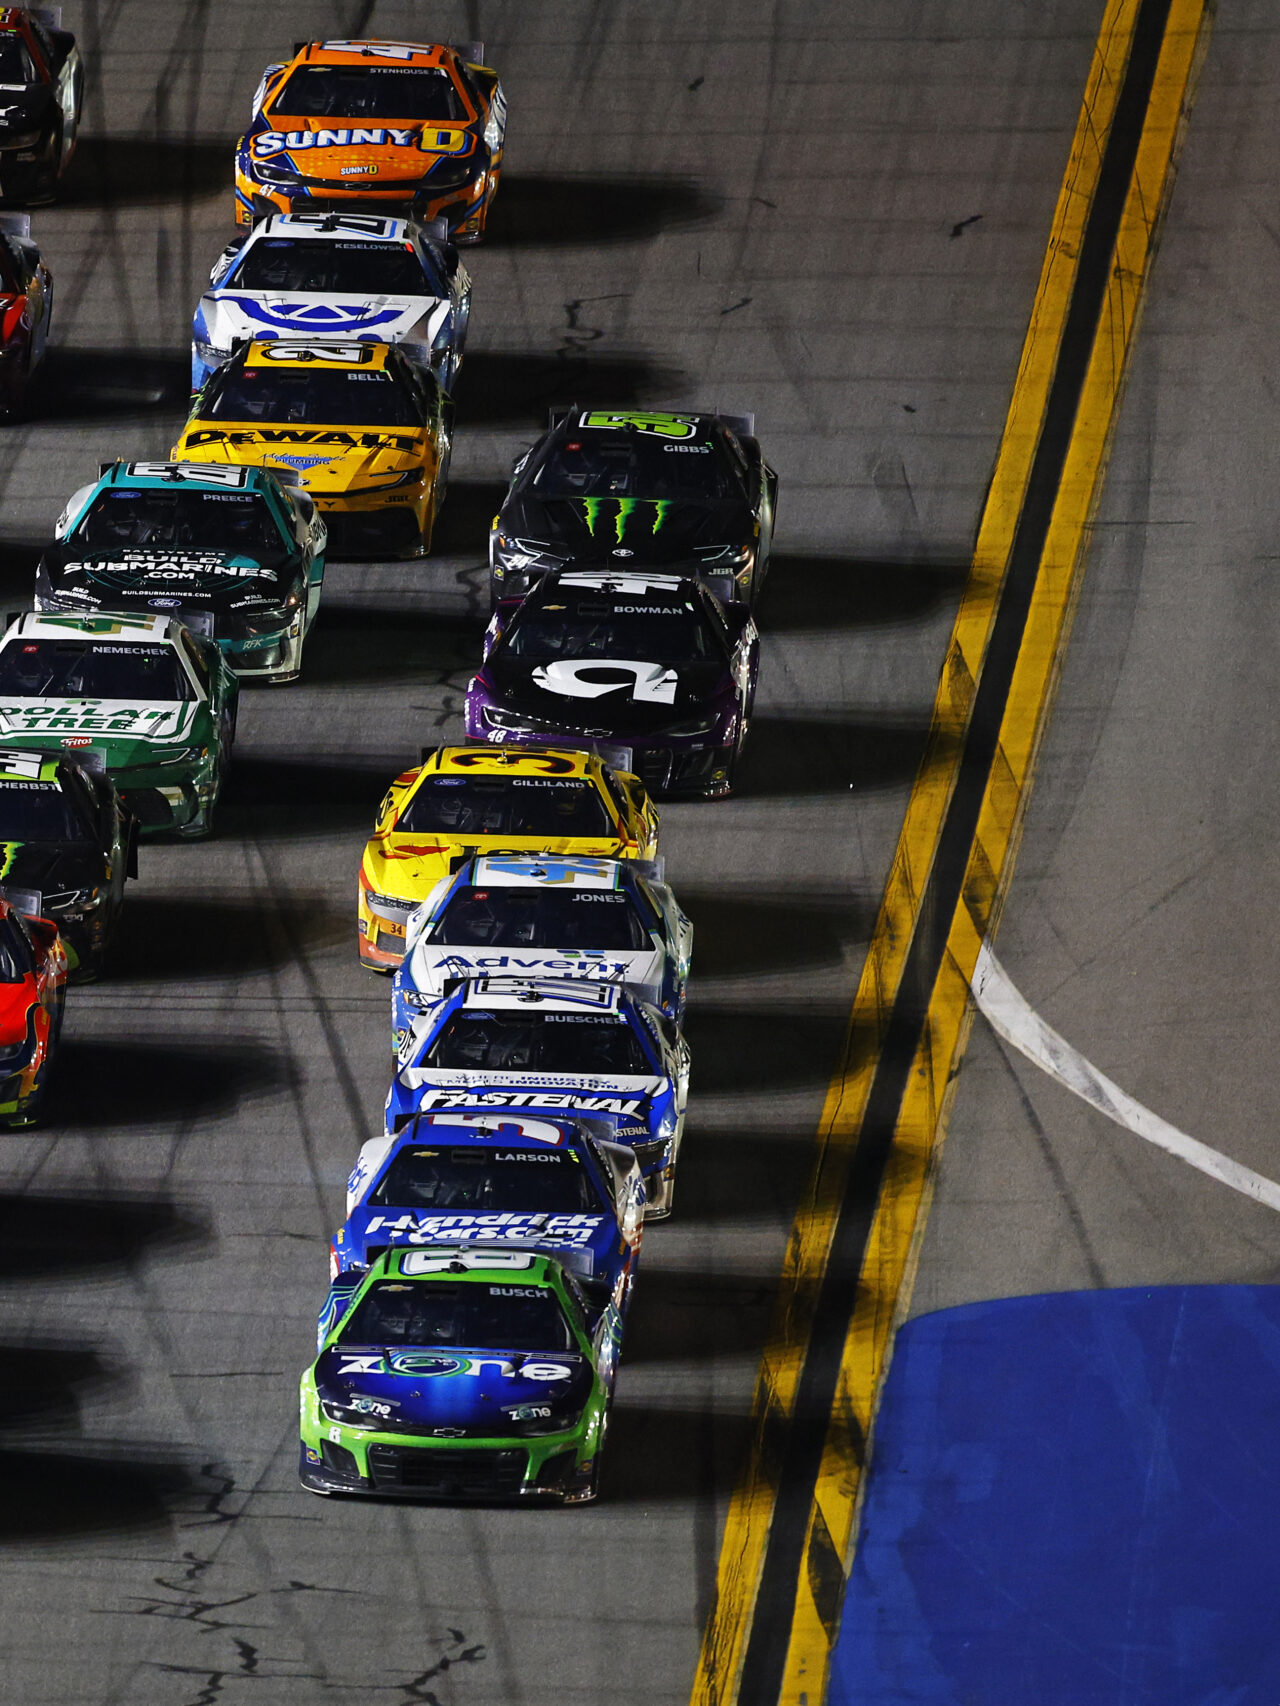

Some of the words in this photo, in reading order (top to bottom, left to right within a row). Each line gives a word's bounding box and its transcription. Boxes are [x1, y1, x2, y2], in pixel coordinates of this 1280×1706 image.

[370, 67, 429, 76] STENHOUSE
[256, 130, 416, 155] SUNNY
[258, 184, 276, 197] 47
[335, 242, 407, 251] KESELOWSKI
[347, 372, 386, 382] BELL
[663, 444, 710, 454] GIBBS
[275, 457, 331, 467] PLUMBING
[203, 493, 253, 503] PREECE
[123, 554, 221, 564] BUILD
[63, 561, 278, 582] SUBMARINES
[143, 571, 195, 580] .COM
[708, 567, 734, 576] JGR
[122, 590, 212, 598] BUILDSUBMARINES.COM
[614, 605, 683, 615] BOWMAN
[92, 646, 170, 656] NEMECHEK
[22, 718, 136, 730] TREE
[487, 729, 506, 743] 48
[60, 737, 93, 747] Fritos
[0, 782, 58, 792] HERBST
[512, 779, 585, 789] GILLILAND
[572, 894, 625, 904] JONES
[390, 923, 403, 935] 34
[433, 956, 631, 975] Advent
[544, 1015, 620, 1025] BUESCHER
[420, 1090, 645, 1121] FASTENAL
[617, 1127, 650, 1137] STENAL
[495, 1153, 561, 1163] LARSON
[365, 1213, 605, 1235] Hendrick
[489, 1287, 548, 1298] BUSCH
[329, 1427, 340, 1444] 8
